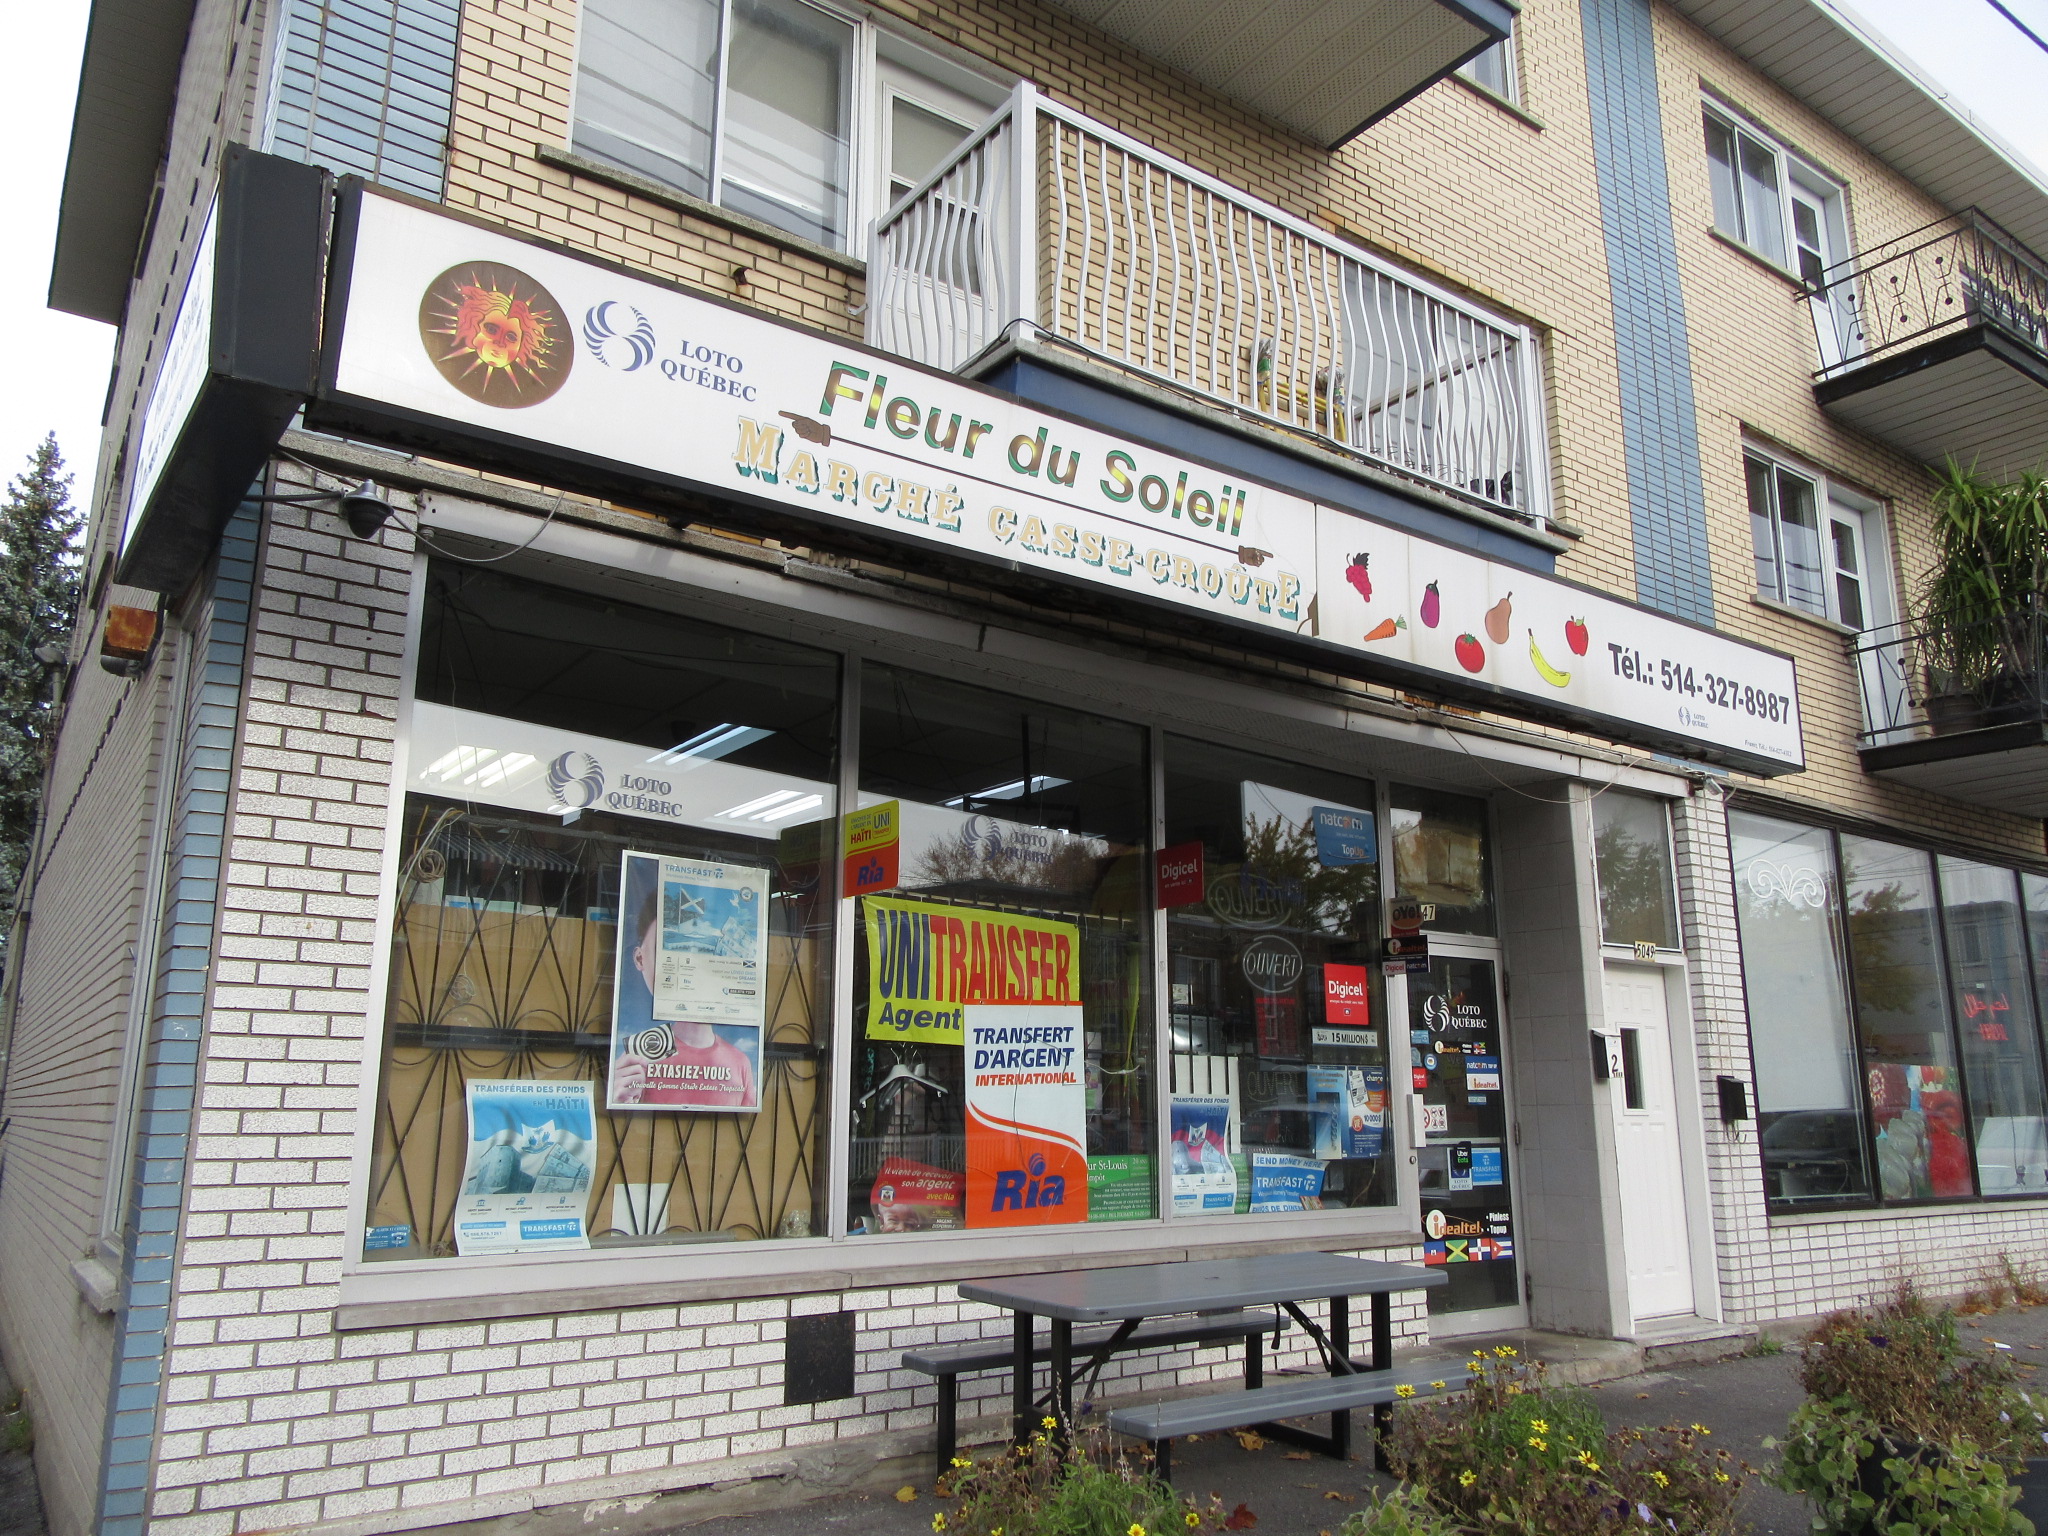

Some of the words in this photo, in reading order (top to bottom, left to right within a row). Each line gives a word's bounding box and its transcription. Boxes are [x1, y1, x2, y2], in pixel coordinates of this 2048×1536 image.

[681, 340, 743, 374] LOTO
[660, 361, 757, 402] QUÉBEC
[818, 360, 993, 459] Fleur
[1007, 426, 1079, 488] du
[1100, 449, 1247, 537] Soleil
[732, 415, 964, 533] MARCHÉ
[988, 505, 1300, 620] CASSE-CROÛTE
[1608, 642, 1654, 686] Tél.:
[1660, 659, 1790, 725] 514-327-8987
[622, 773, 672, 795] LOTO
[608, 791, 682, 817] QUÉBEC
[873, 811, 890, 829] UNI
[850, 829, 871, 844] HAÏTI
[1011, 831, 1047, 847] LOTO
[664, 864, 712, 878] TRANSFAST
[857, 857, 884, 886] Ria
[1161, 858, 1198, 880] Digicel
[876, 908, 1071, 1003] UNITRANSFER
[1637, 943, 1655, 959] 5049
[1246, 953, 1298, 976] OUVERT
[1328, 980, 1364, 998] Digicel
[878, 1001, 961, 1031] Agent
[1457, 1004, 1480, 1015] LOTO
[1451, 1016, 1488, 1029] QUÉBEC
[973, 1027, 1074, 1045] TRANSFERT
[1331, 1032, 1341, 1043] 15
[974, 1048, 1074, 1069] D'ARGENT
[1611, 1054, 1619, 1073] 2
[647, 1063, 732, 1081] EXTASIEZ-VOUS
[975, 1072, 1077, 1087] INTERNATIONAL
[475, 1084, 534, 1093] TRANSFÉRER
[536, 1085, 554, 1093] DES
[545, 1096, 585, 1110] HAÏTI
[1098, 1159, 1128, 1170] St-Louis
[1256, 1156, 1277, 1165] SEND
[1279, 1157, 1302, 1166] MONEY
[1303, 1160, 1324, 1168] HERE
[892, 1168, 911, 1176] vient
[922, 1171, 954, 1179] recevoir
[1256, 1176, 1303, 1188] TRANSFAST
[916, 1179, 956, 1191] argent
[991, 1153, 1066, 1213] Ria
[1489, 1212, 1510, 1222] Pinless
[523, 1224, 566, 1233] TRANSFAST
